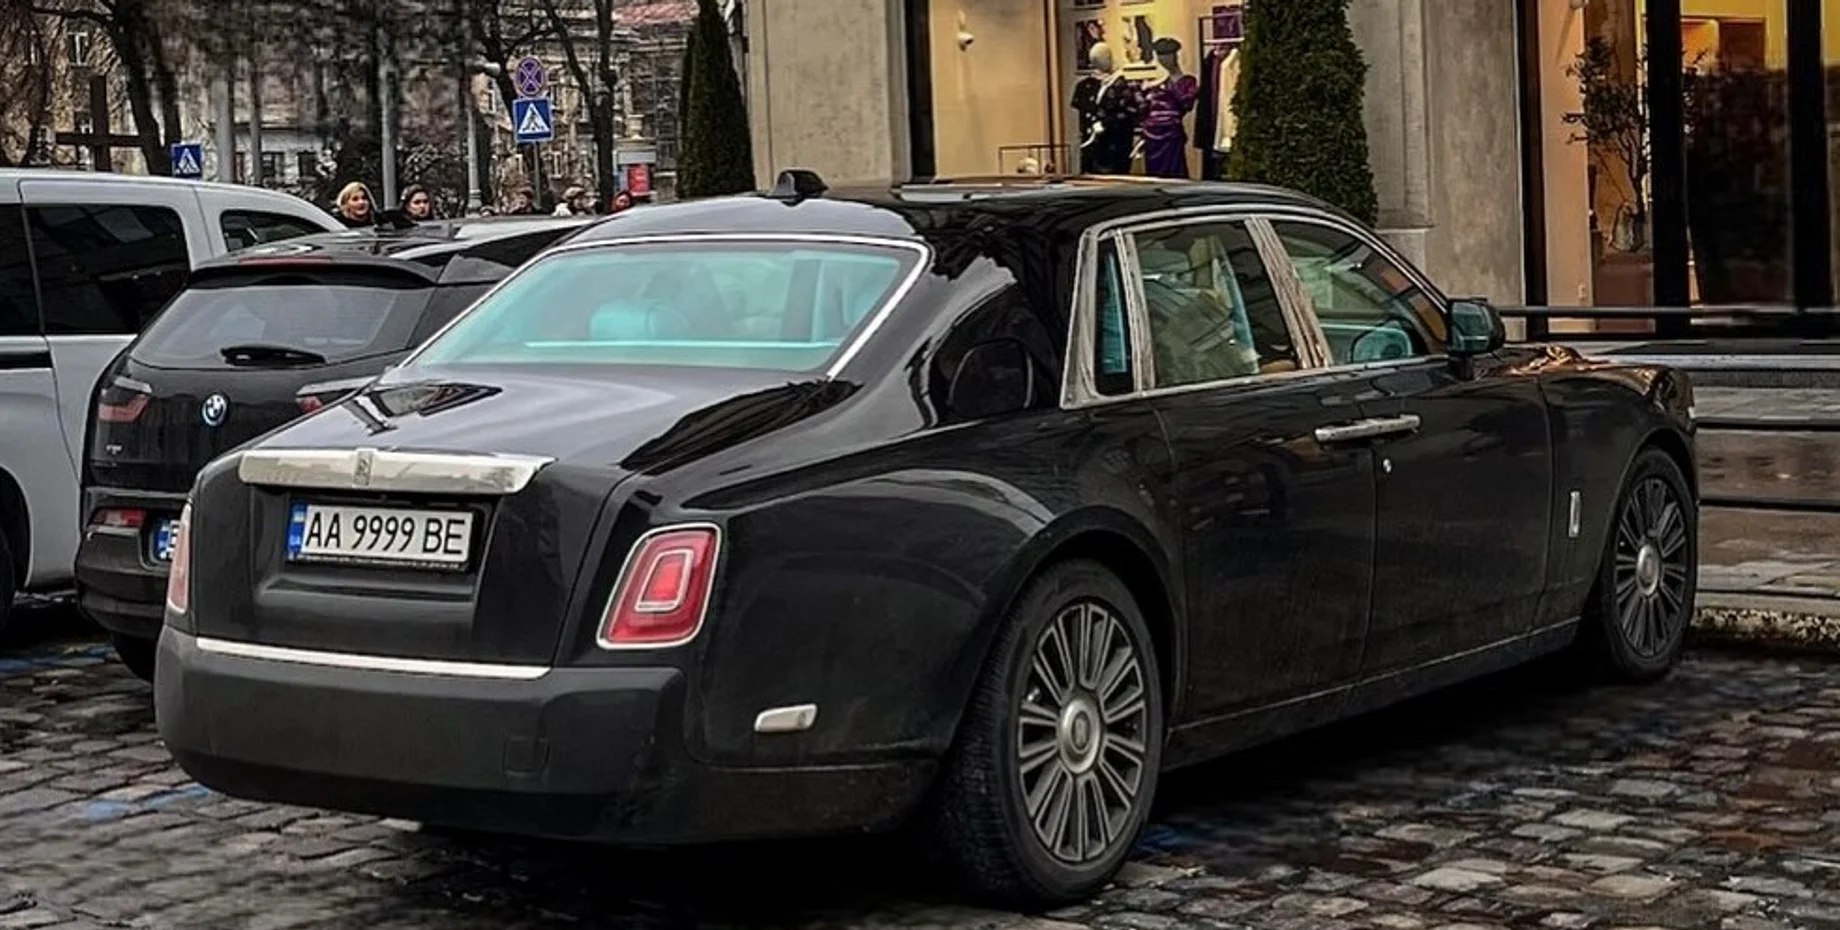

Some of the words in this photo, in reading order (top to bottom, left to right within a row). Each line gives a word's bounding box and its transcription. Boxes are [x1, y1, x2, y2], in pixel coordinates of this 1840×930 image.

[305, 511, 342, 549] AA
[351, 514, 416, 553] 9999
[422, 517, 466, 555] BE
